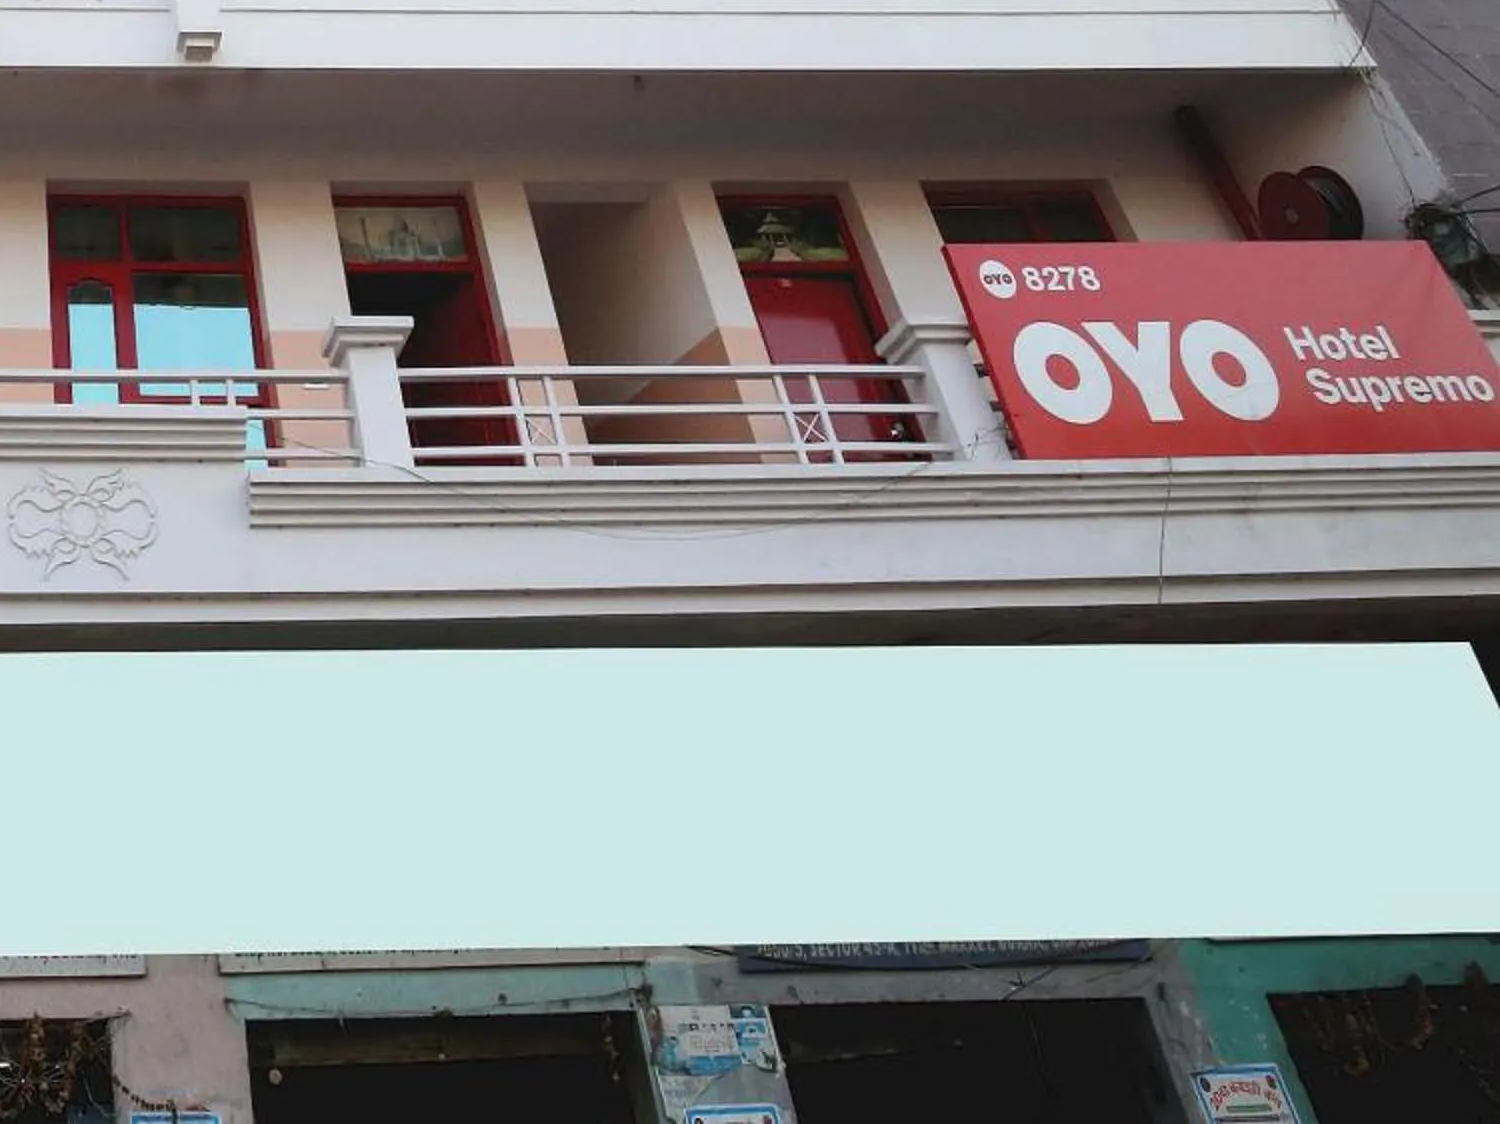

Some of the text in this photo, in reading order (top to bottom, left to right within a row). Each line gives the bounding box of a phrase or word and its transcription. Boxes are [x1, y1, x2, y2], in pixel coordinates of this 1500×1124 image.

[983, 265, 1100, 291] OYO 8278
[1283, 326, 1399, 360] Hotel
[1013, 320, 1279, 424] OYO
[1306, 369, 1495, 410] Supremo
